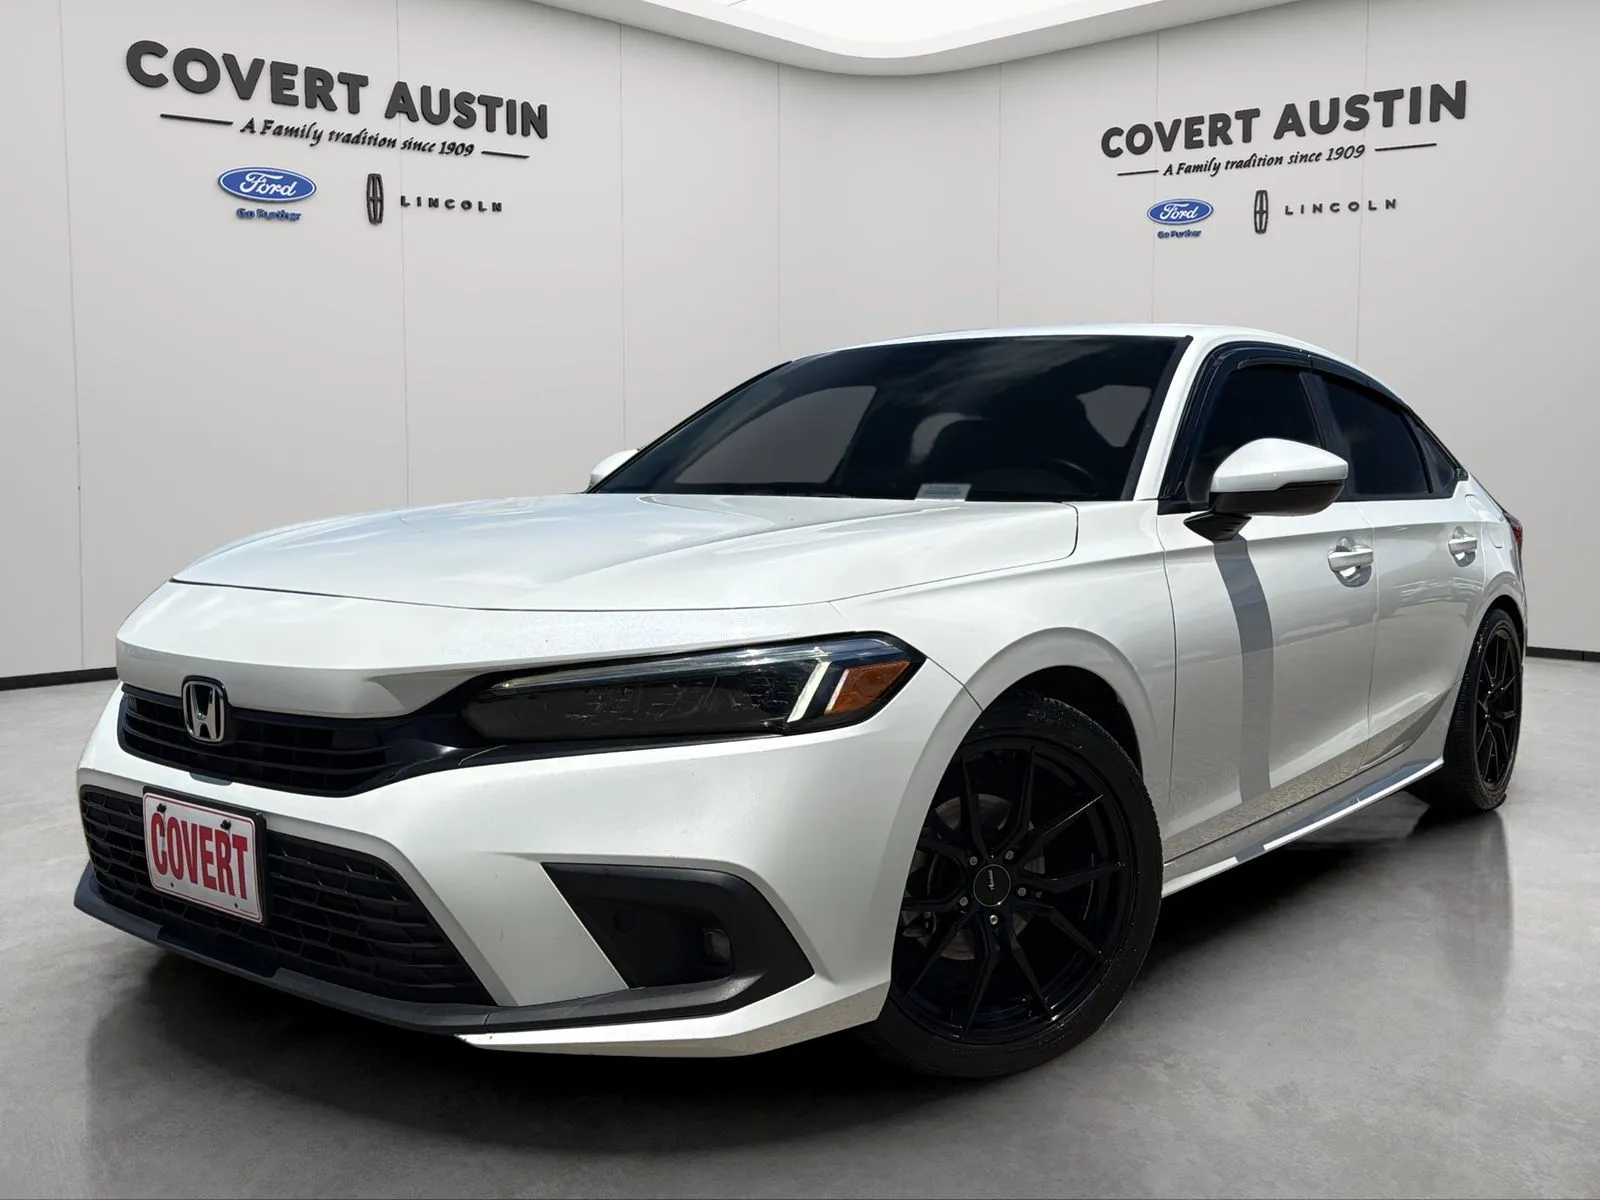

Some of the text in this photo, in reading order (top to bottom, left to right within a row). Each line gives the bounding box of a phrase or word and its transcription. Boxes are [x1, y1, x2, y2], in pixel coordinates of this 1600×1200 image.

[126, 40, 548, 140] COVERT AUSTIN
[1101, 80, 1467, 159] COVERT AUSTIN
[239, 117, 475, 157] A Family tradition since 1909
[1162, 144, 1366, 178] A Family tradition since 1909
[239, 171, 298, 197] Ford
[400, 195, 502, 213] LINCOLN
[1159, 202, 1200, 220] Ford
[1284, 198, 1397, 216] LINCOLN
[151, 811, 248, 900] COVERT
